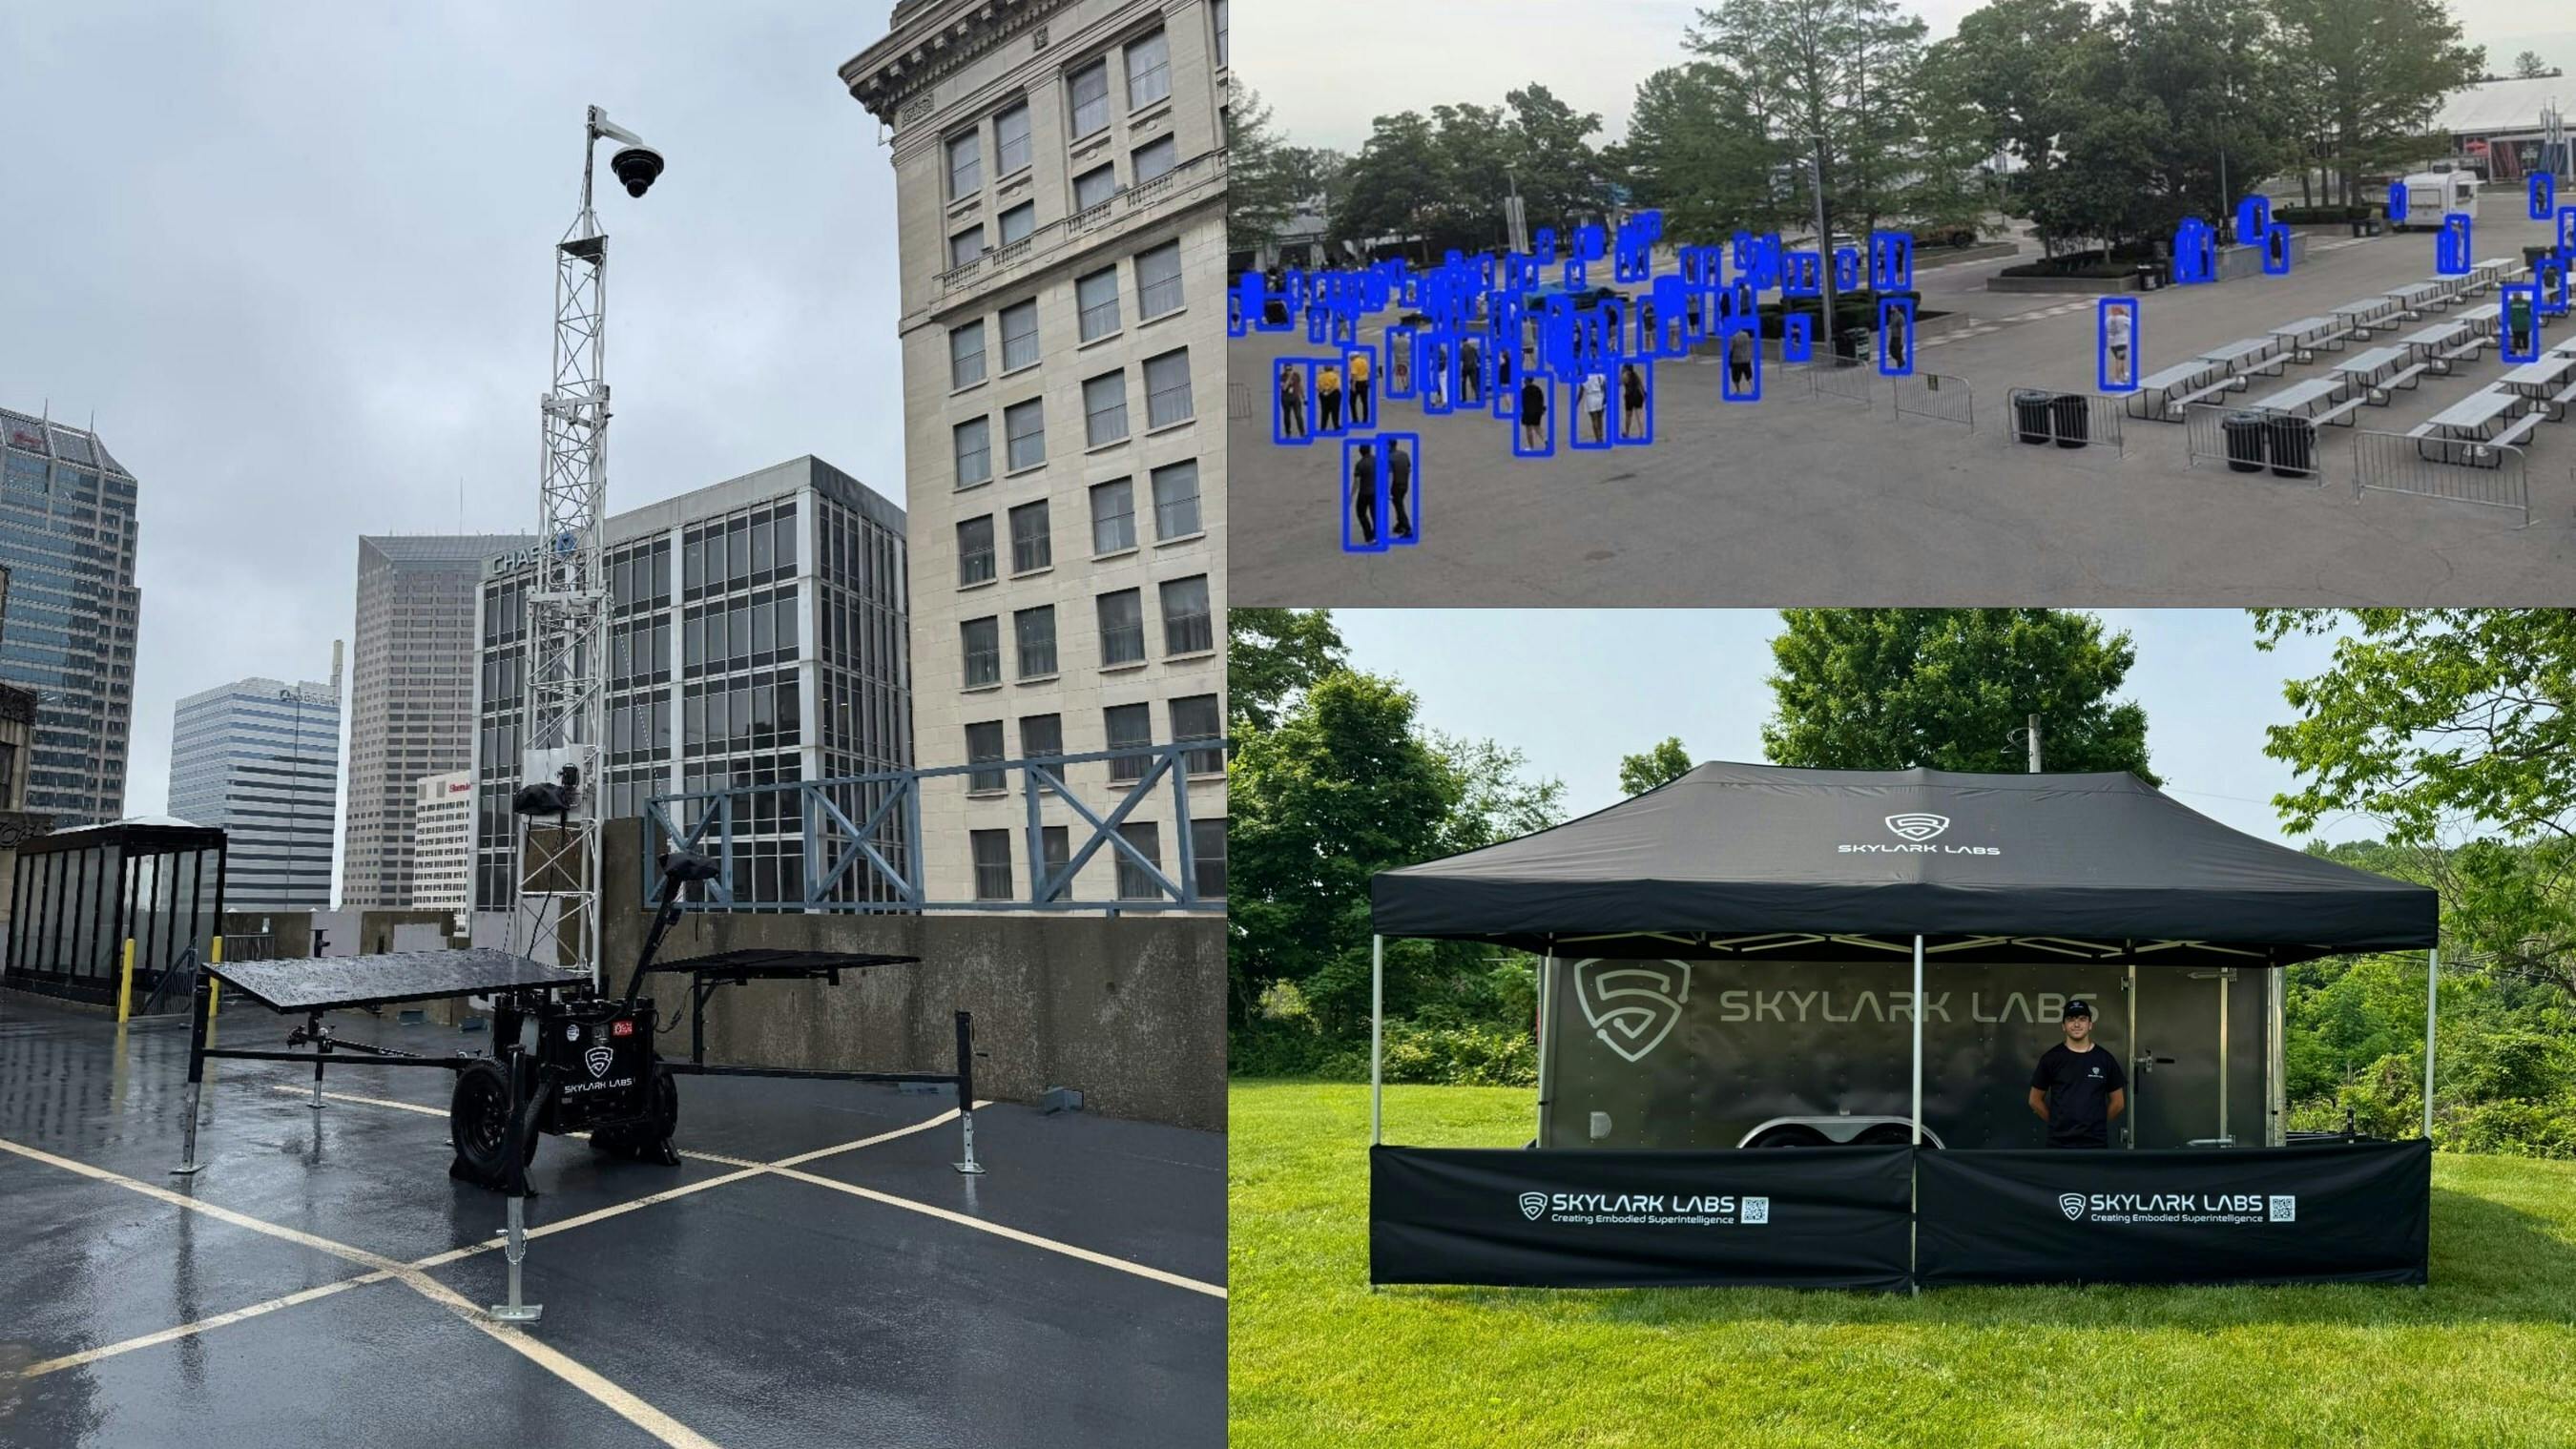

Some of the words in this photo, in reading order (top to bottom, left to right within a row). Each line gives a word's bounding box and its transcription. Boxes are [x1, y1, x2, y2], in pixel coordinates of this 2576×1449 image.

[492, 546, 550, 573] CHAS
[1838, 844, 1938, 854] SKYLARK
[1944, 845, 2001, 856] LABS
[1719, 990, 1951, 1023] SKYLARK
[564, 1082, 607, 1094] SKYLARK
[609, 1077, 633, 1087] LABS
[1551, 1193, 1665, 1212] SKYLARK
[1672, 1195, 1735, 1213] LABS
[2089, 1193, 2196, 1211] SKYLARK
[2203, 1194, 2263, 1212] LABS
[1551, 1213, 1594, 1225] Creating
[1595, 1214, 1647, 1224] Embodied
[1648, 1214, 1735, 1226] Superintelligence
[2090, 1213, 2130, 1224] Creating
[2131, 1213, 2180, 1222] Embodied
[2181, 1213, 2264, 1225] Superintelligence
